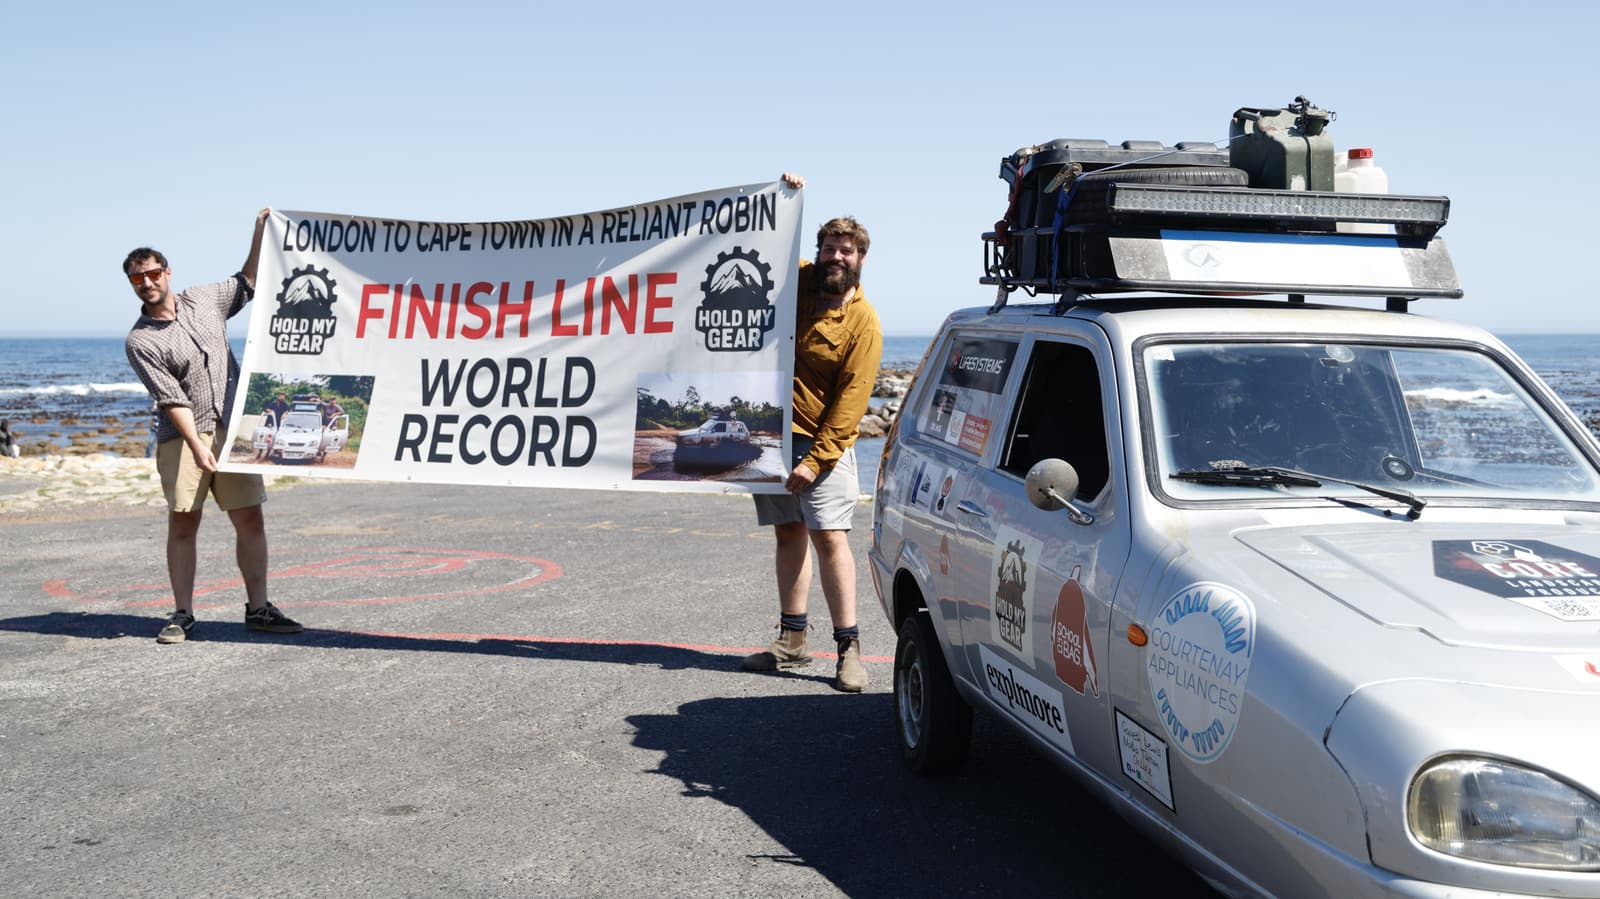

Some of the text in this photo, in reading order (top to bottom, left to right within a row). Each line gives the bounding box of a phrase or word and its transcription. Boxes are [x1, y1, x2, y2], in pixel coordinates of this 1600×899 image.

[283, 193, 777, 252] LONDON TO CAPE TOWN IN A RELIANT ROBIN
[356, 272, 678, 339] FINISH LINE
[698, 310, 774, 329] HOLD MY
[272, 317, 335, 336] HOLD MY
[707, 329, 761, 349] GEAR
[276, 335, 325, 353] GEAR
[421, 356, 597, 408] WORLD
[394, 413, 598, 467] RECORD
[1482, 562, 1598, 578] CORE
[996, 597, 1025, 626] HOLD MY
[1000, 622, 1022, 648] GEAR
[1057, 621, 1081, 649] SCHOOL
[1063, 641, 1081, 665] BAG
[1151, 627, 1247, 684] COURTENAY
[986, 662, 1064, 734] explmore
[1149, 653, 1238, 715] APPLIANCES
